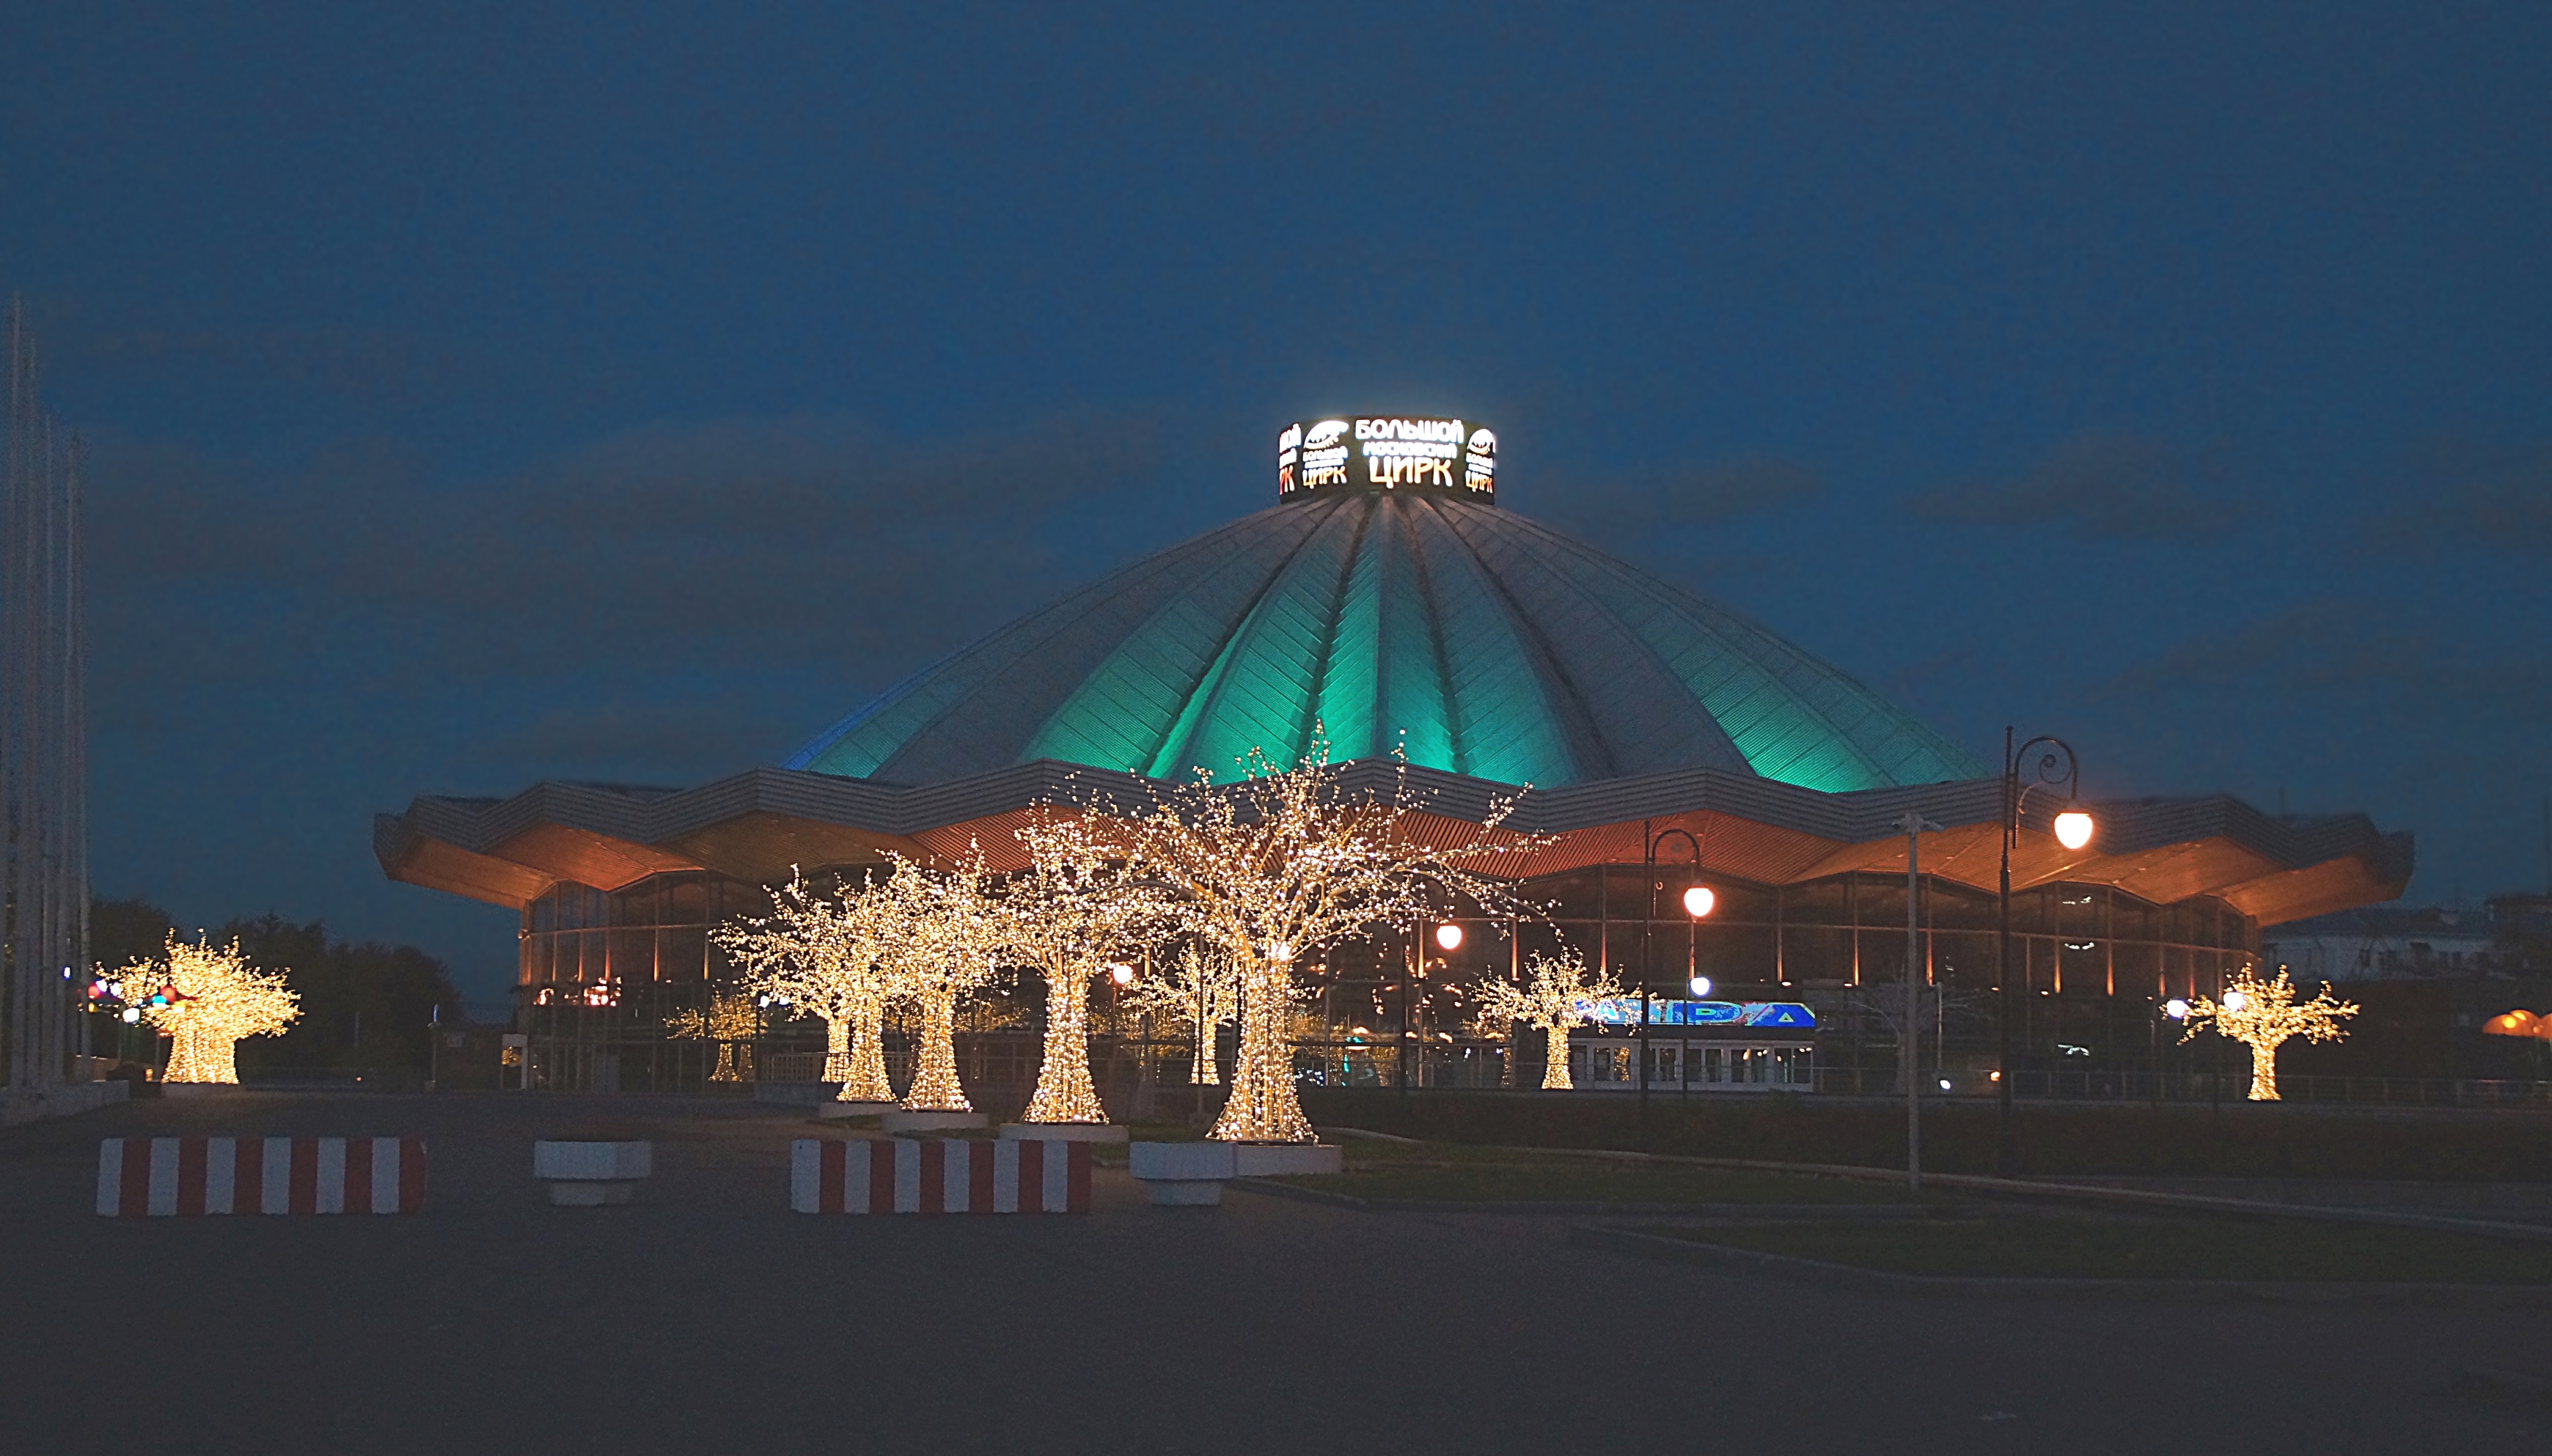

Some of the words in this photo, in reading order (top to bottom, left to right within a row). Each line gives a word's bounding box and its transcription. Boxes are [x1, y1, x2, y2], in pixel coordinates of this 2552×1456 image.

[1355, 419, 1464, 444] БОЛЬШОЙ
[1302, 466, 1347, 489] ЦИРК
[1369, 456, 1453, 489] ЦИРК
